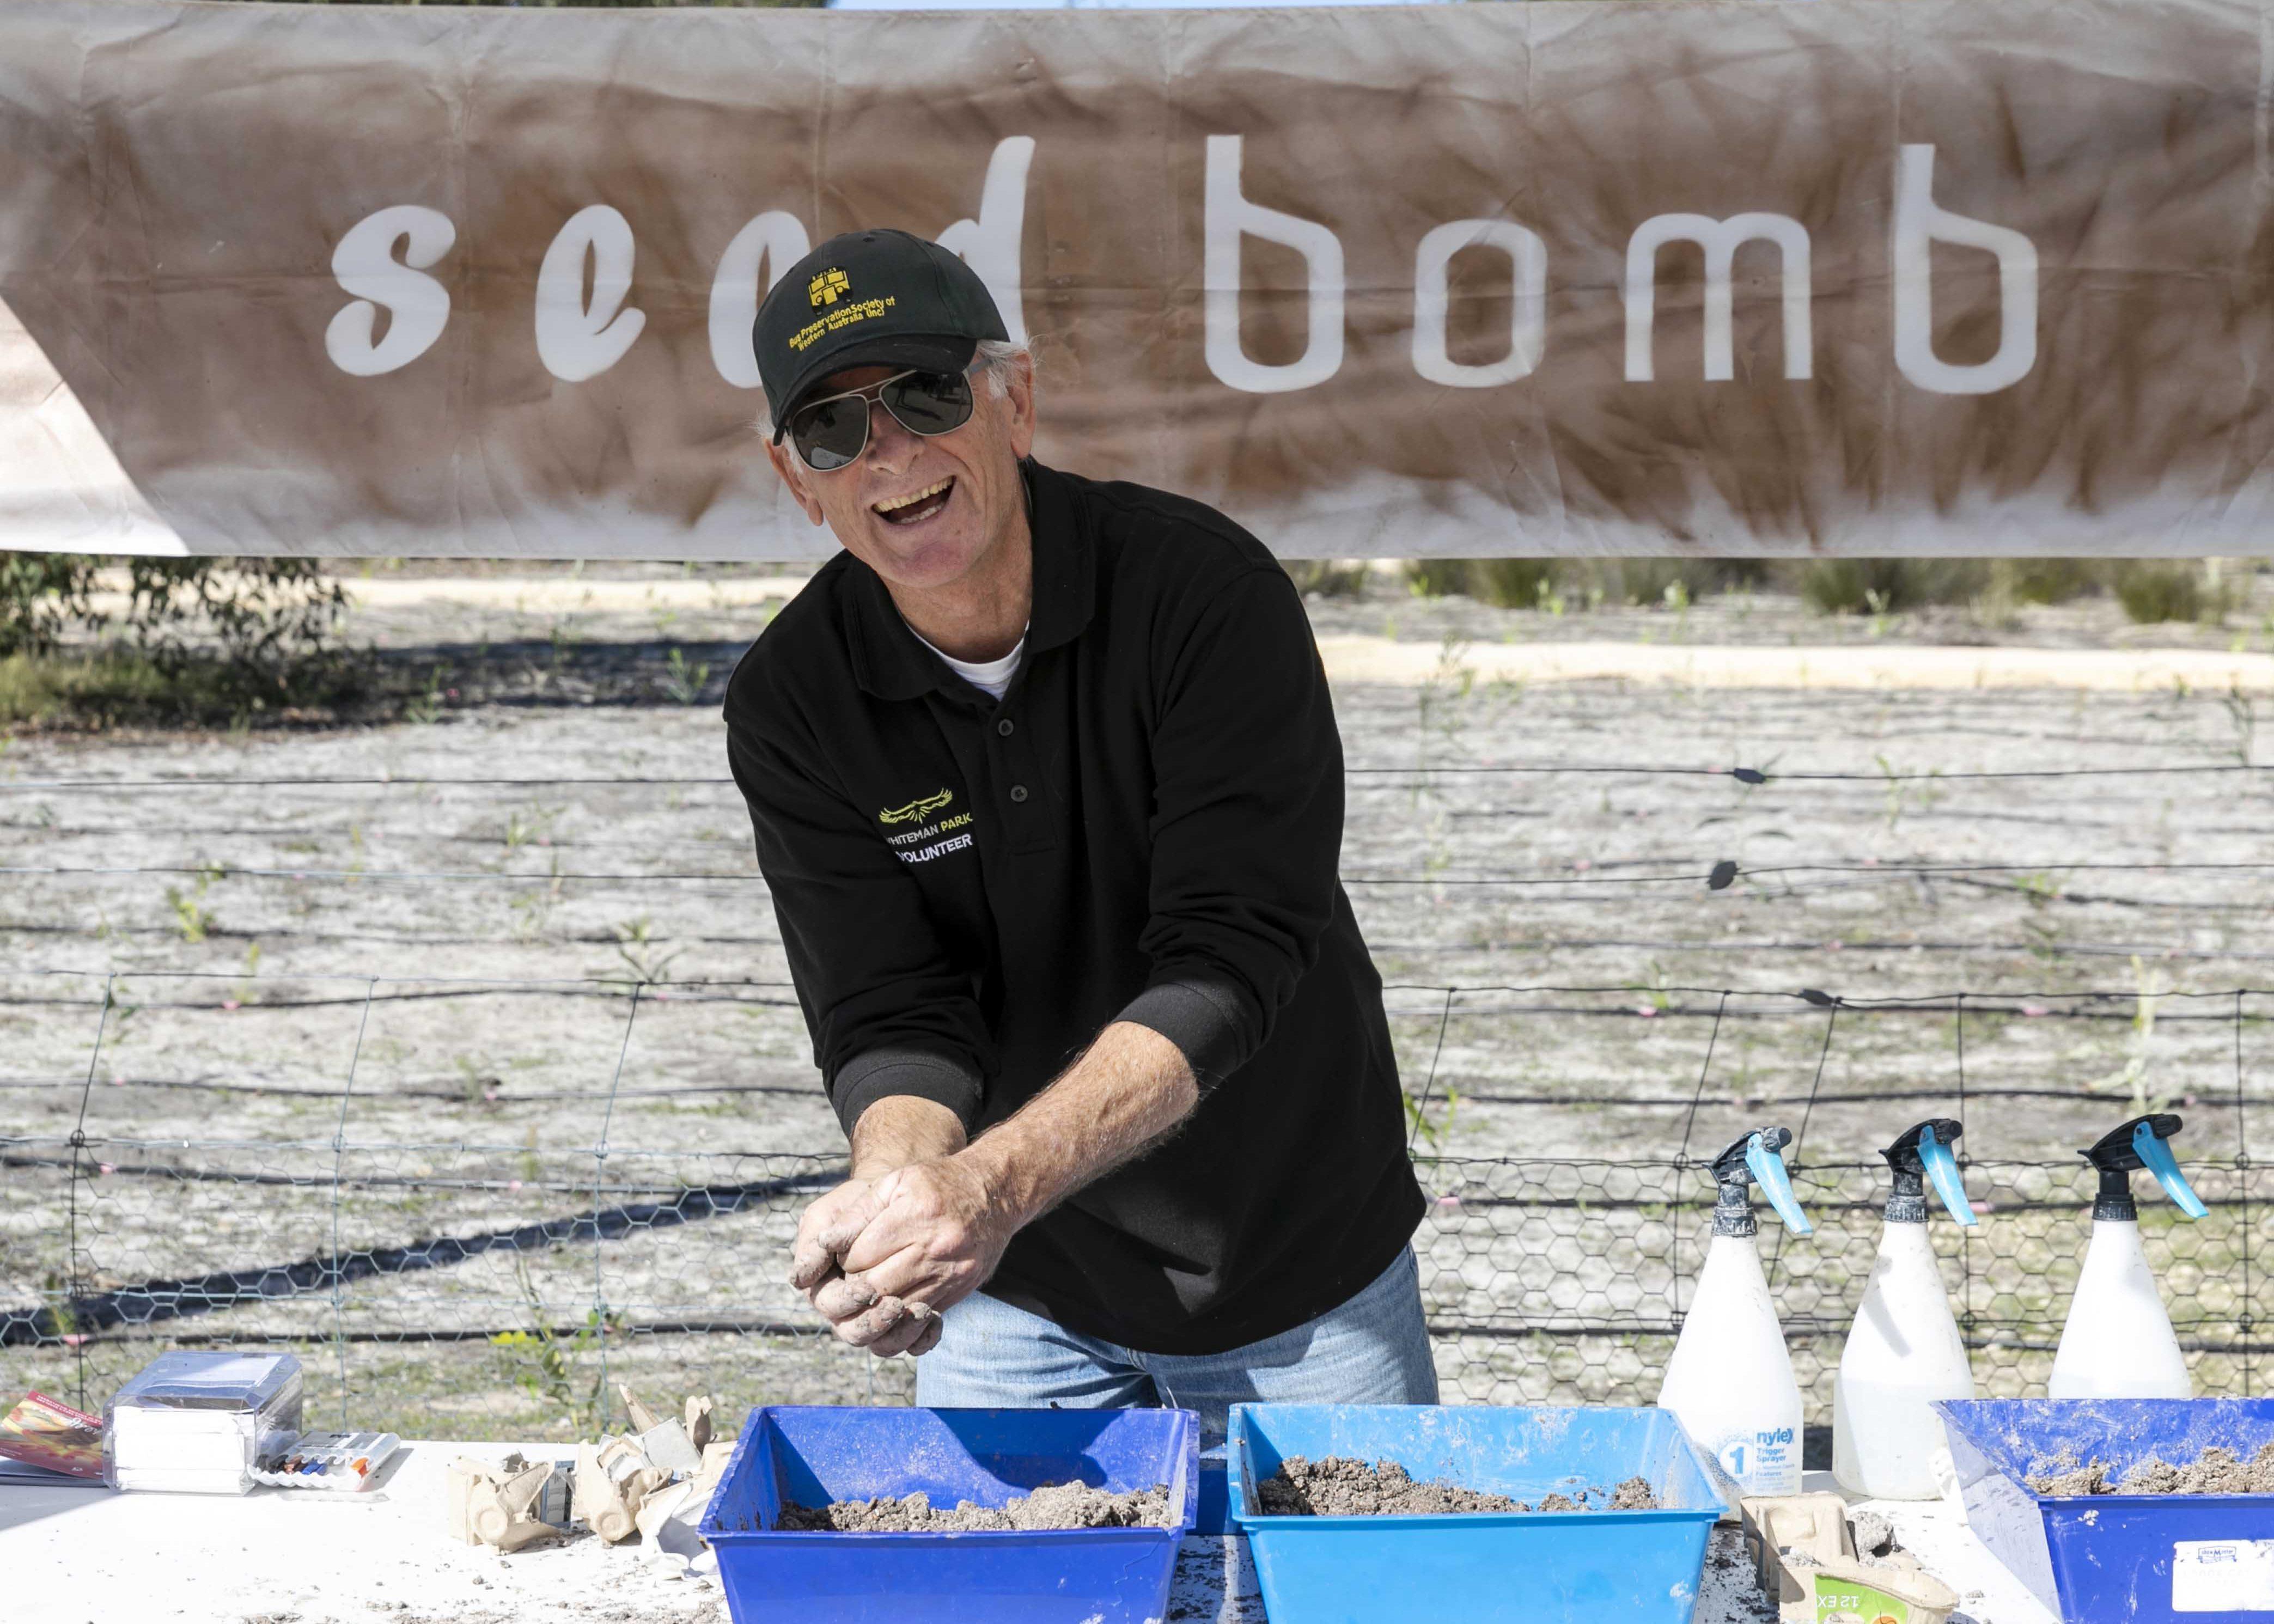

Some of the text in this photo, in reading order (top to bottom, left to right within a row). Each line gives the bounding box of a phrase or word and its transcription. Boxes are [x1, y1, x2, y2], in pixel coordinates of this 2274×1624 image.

[1204, 134, 2039, 394] bomb
[789, 334, 801, 347] Bus
[886, 296, 895, 306] of
[798, 329, 825, 351] Western
[828, 314, 863, 330] Australia
[941, 813, 972, 831] PARK
[895, 834, 972, 862] VOLUNTEER
[1729, 1447, 1743, 1473] 1
[1818, 1595, 1858, 1607] 12 EX
